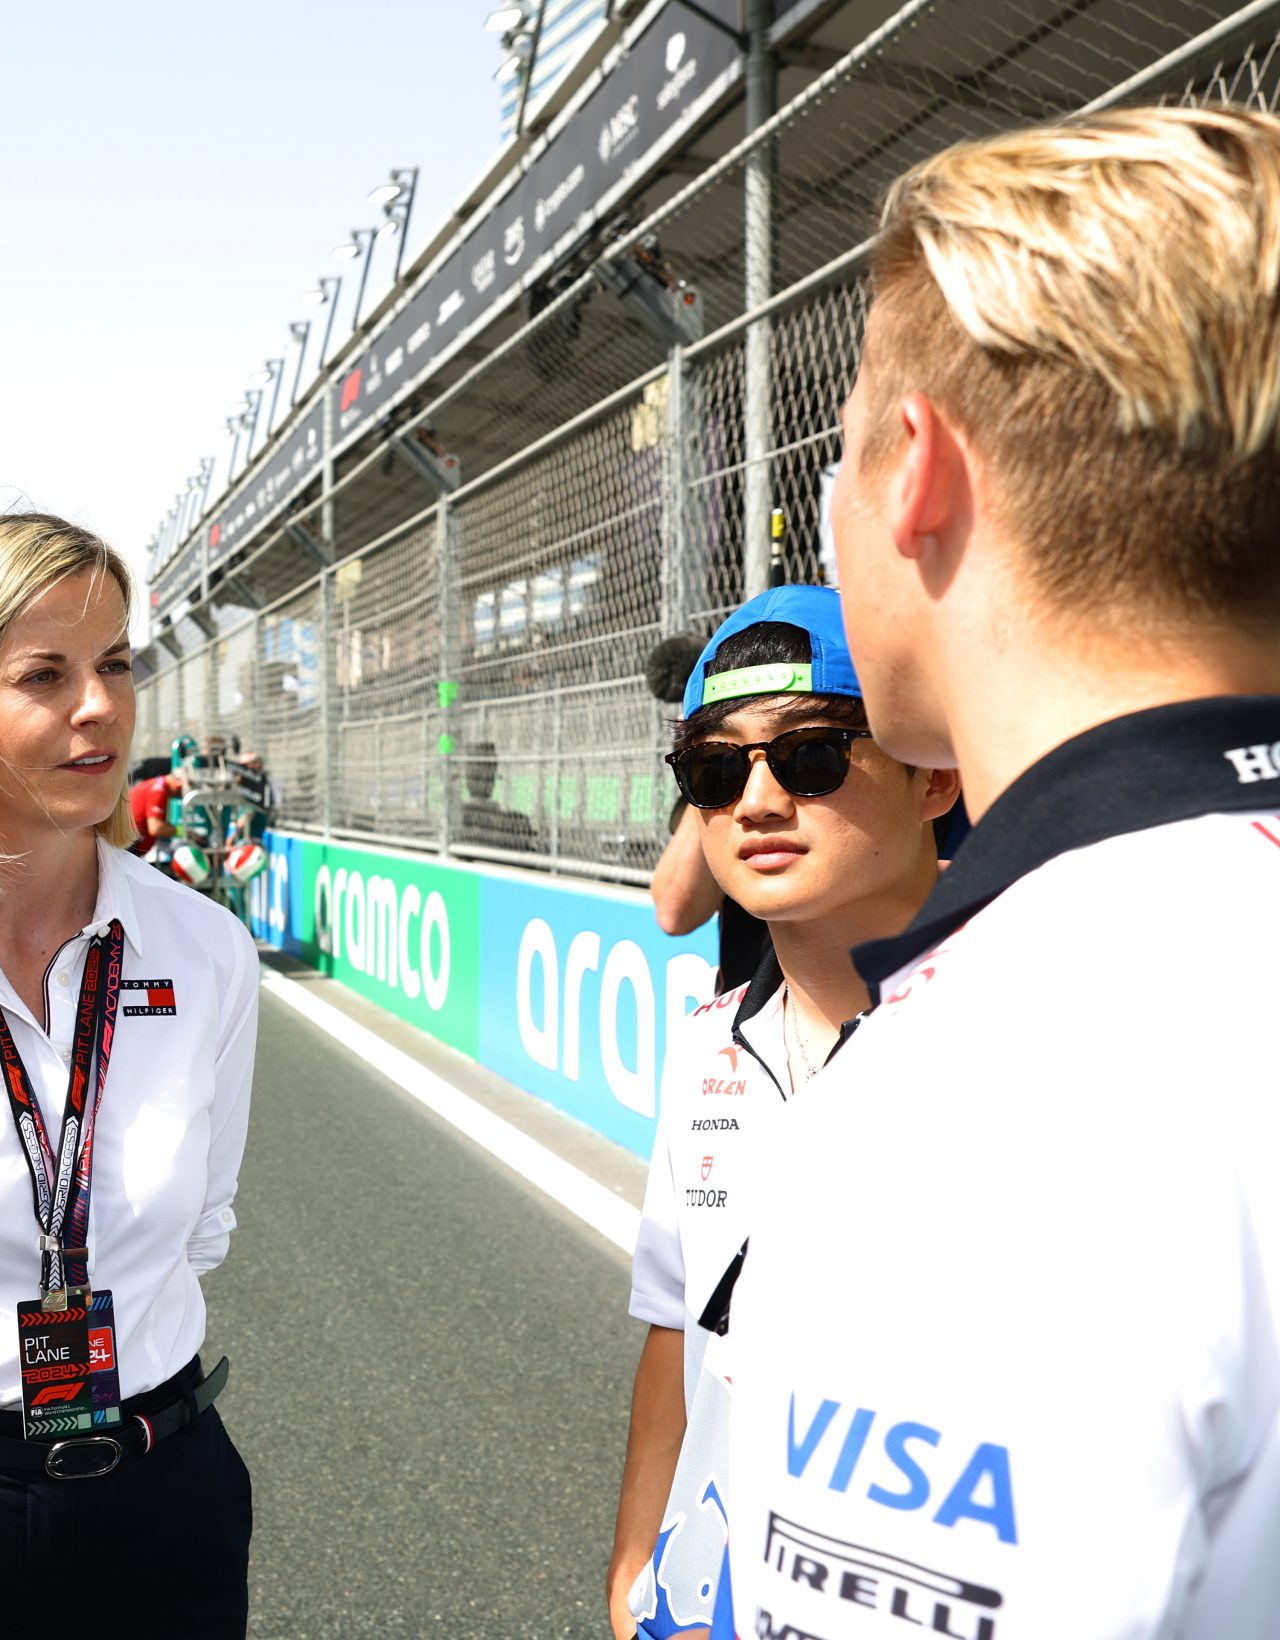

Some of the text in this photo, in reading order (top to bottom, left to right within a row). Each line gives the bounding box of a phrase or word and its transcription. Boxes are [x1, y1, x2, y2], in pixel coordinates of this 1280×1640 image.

[314, 864, 451, 1011] aramco
[105, 942, 121, 1021] ACADEMY
[79, 994, 96, 1037] LANE
[0, 1036, 17, 1061] PIT
[76, 1039, 91, 1065] PIT
[702, 1078, 747, 1096] ORLEN
[691, 1118, 740, 1131] HONDA
[22, 1121, 45, 1171] ACCESS
[61, 1127, 77, 1177] ACCESS
[685, 1189, 728, 1208] TUDOR
[24, 1335, 50, 1351] PIT
[26, 1347, 70, 1365] LANE
[27, 1365, 78, 1382] 2024
[786, 1390, 1018, 1546] VISA
